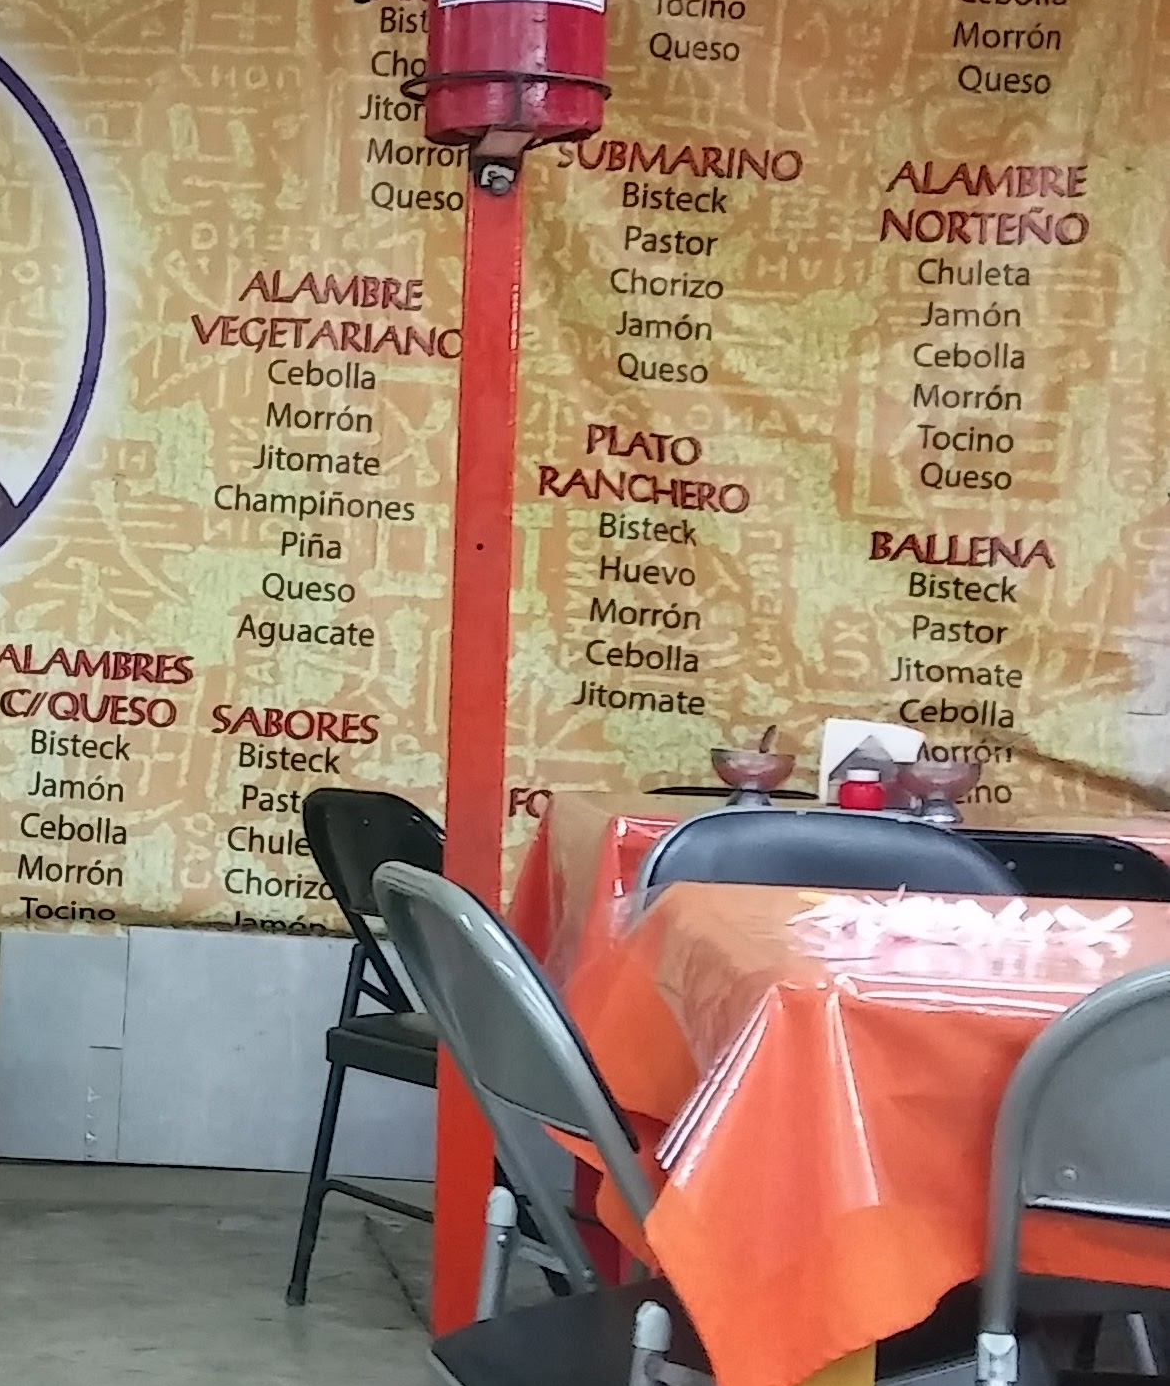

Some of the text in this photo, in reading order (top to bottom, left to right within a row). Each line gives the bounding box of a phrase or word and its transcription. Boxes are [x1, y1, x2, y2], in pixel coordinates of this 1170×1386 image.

[381, 6, 428, 33] Bist
[650, 33, 739, 61] Queso
[953, 21, 1061, 50] Morrón
[958, 65, 1051, 94] Queso
[558, 140, 802, 182] SUBMARINO
[885, 161, 1088, 198] ALAMBRE
[371, 182, 463, 211] Queso
[623, 182, 727, 213] Bisteck
[625, 226, 718, 256] Pastor
[880, 207, 1089, 245] NORTEÑO
[610, 268, 724, 299] Chorizo
[918, 258, 1030, 286] Chuleta
[239, 270, 423, 311] ALAMBRE
[616, 311, 711, 341] Jamón
[920, 301, 1020, 327] Jamón
[191, 315, 464, 359] VEGETARIANO
[618, 353, 708, 383] Queso
[914, 342, 1024, 369] Cebolla
[268, 359, 375, 389] Cebolla
[914, 384, 1021, 410] Morrón
[267, 402, 372, 433] Morrón
[587, 424, 702, 465] PLATO
[917, 424, 1013, 453] Tocino
[253, 444, 380, 476] Jitomate
[539, 465, 750, 513] RANCHERO
[921, 462, 1011, 490] Queso
[215, 484, 414, 521] Champiñones
[599, 512, 696, 546] Bisteck
[281, 531, 341, 559] Piña
[869, 531, 1055, 569] BALLENA
[600, 555, 695, 586] Huevo
[262, 573, 355, 603] Queso
[909, 572, 1017, 602] Bisteck
[590, 597, 700, 630] Morrón
[237, 614, 374, 647] Aguacate
[913, 615, 1008, 644] Pastor
[586, 640, 698, 672] Cebolla
[890, 657, 1022, 688] Jitomate
[570, 681, 705, 715] Jitomate
[212, 705, 380, 744] SABORES
[899, 698, 1013, 732] Cebolla
[32, 729, 130, 761] Bisteck
[239, 742, 340, 774] Bisteck
[28, 771, 123, 802] Jamón
[242, 784, 301, 813] Past
[21, 813, 126, 845] Cebolla
[228, 826, 310, 856] Chule
[18, 854, 122, 887] Morrón
[225, 868, 335, 900] Chorizo
[21, 898, 116, 922] Tocino
